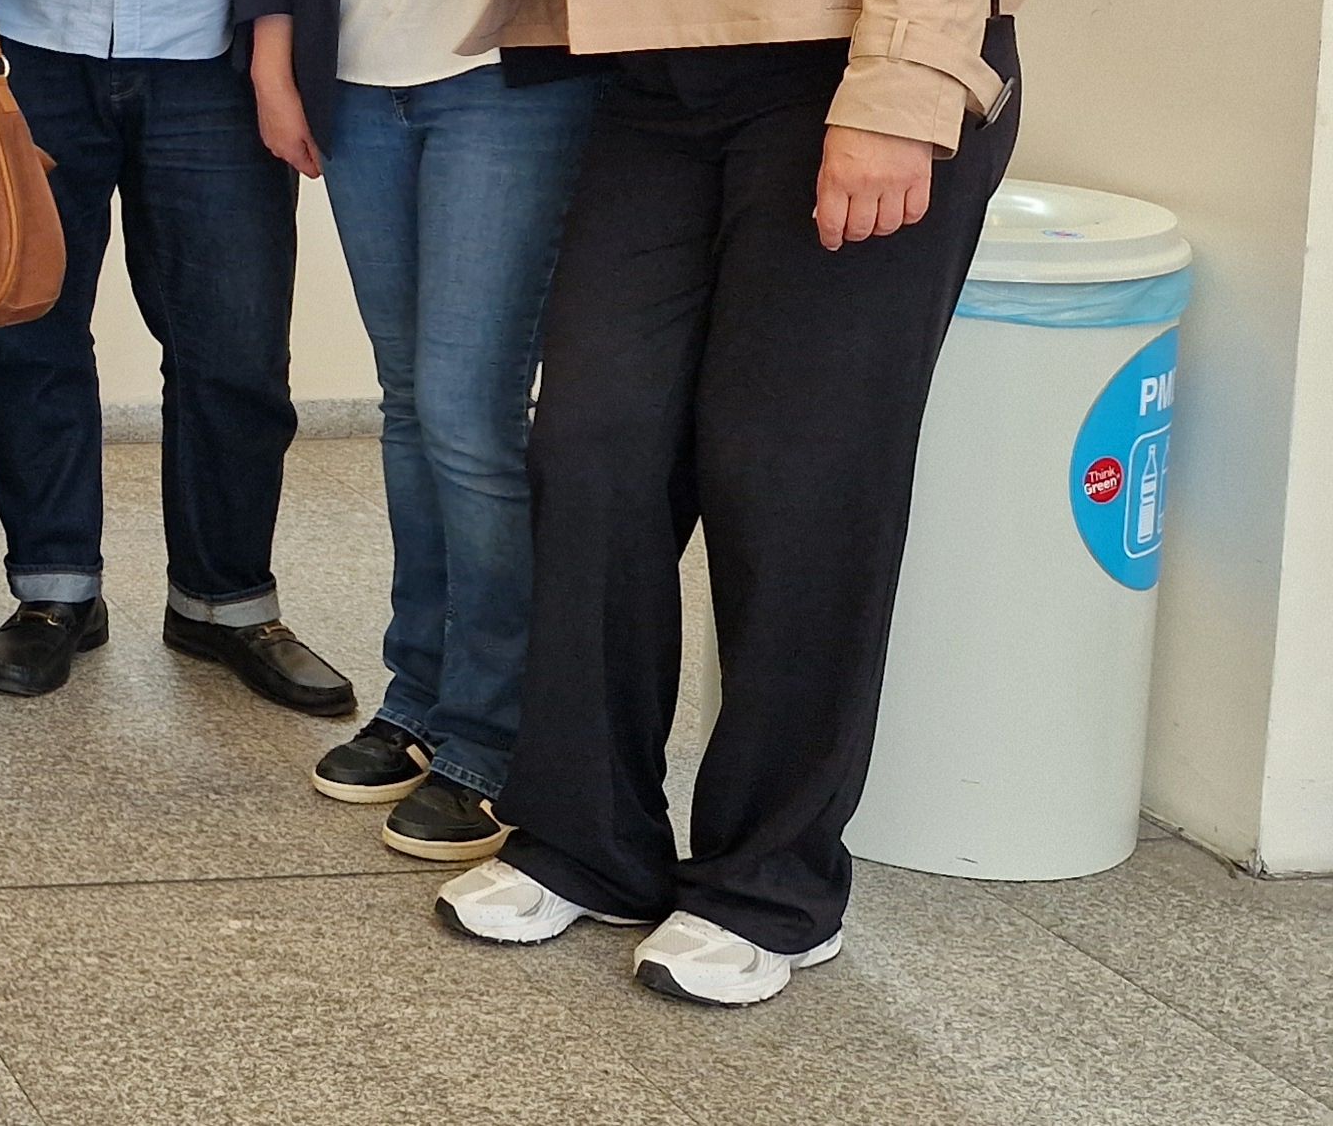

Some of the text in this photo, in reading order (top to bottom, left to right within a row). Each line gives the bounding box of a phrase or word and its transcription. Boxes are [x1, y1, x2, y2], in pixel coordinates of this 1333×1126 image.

[1139, 365, 1177, 416] PM
[1088, 465, 1117, 483] Think
[1083, 477, 1117, 496] Green
